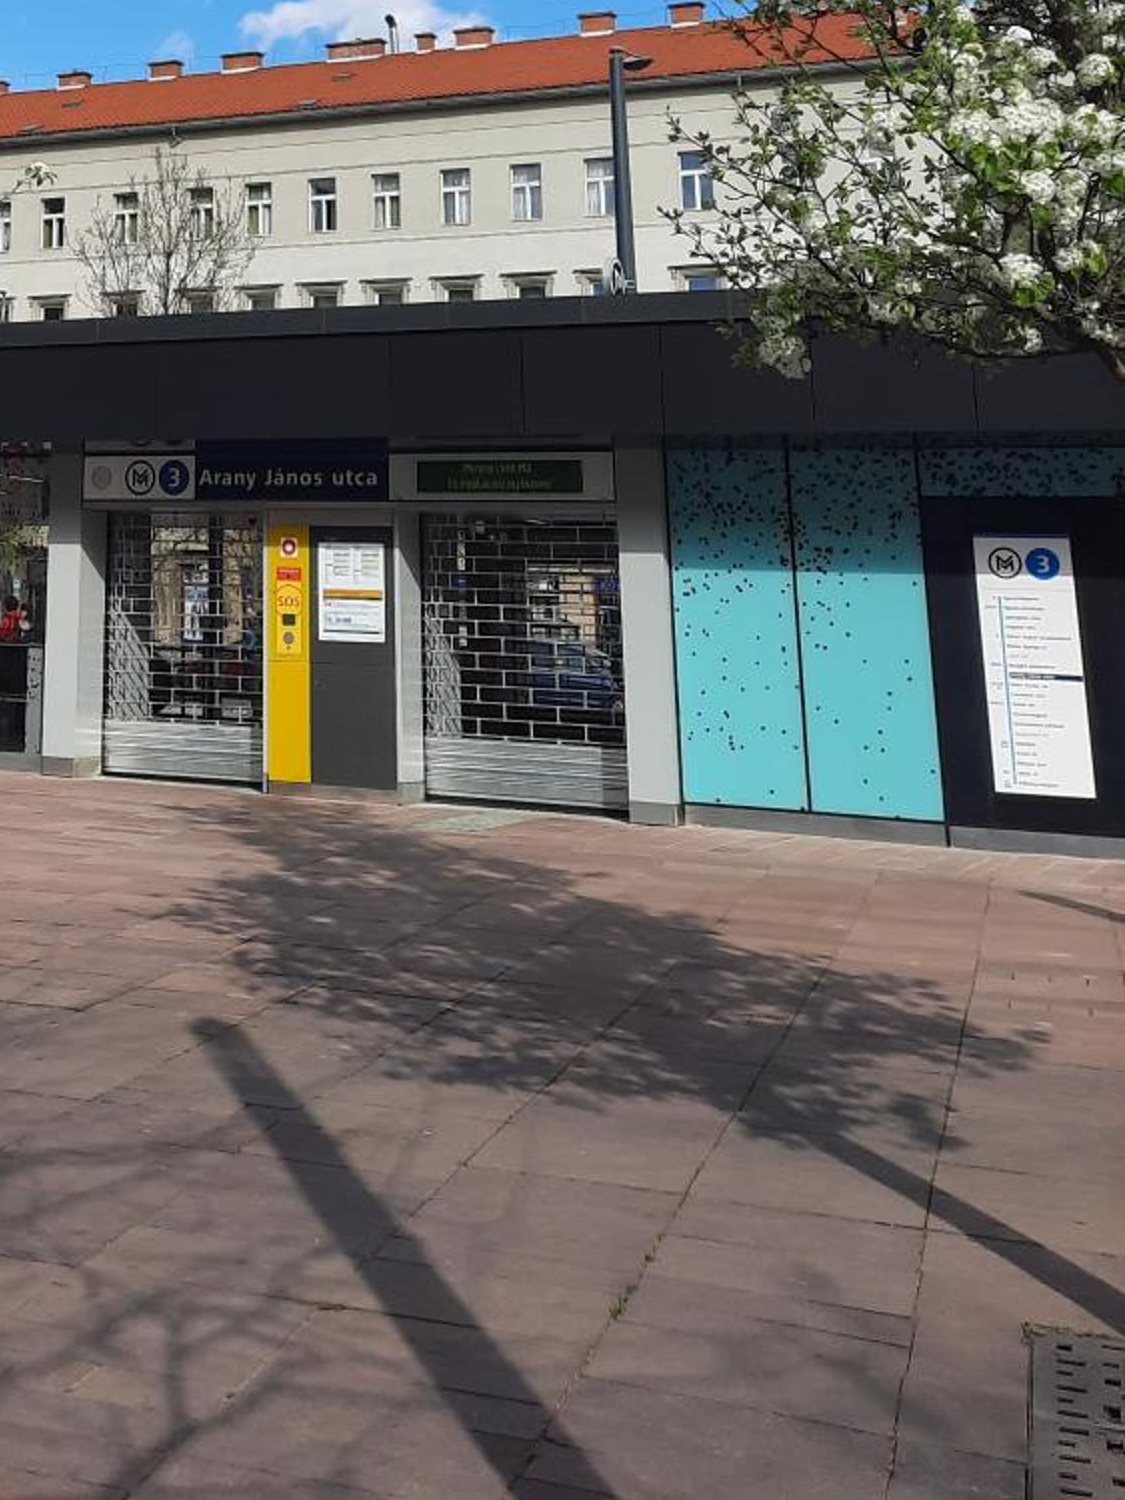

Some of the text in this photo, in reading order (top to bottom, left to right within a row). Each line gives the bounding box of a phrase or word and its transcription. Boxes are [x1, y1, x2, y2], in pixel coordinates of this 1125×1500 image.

[168, 467, 180, 487] 3
[199, 469, 256, 491] Arany
[264, 467, 323, 486] János
[332, 469, 378, 486] utca
[1036, 555, 1050, 573] 3
[278, 595, 300, 607] SOS
